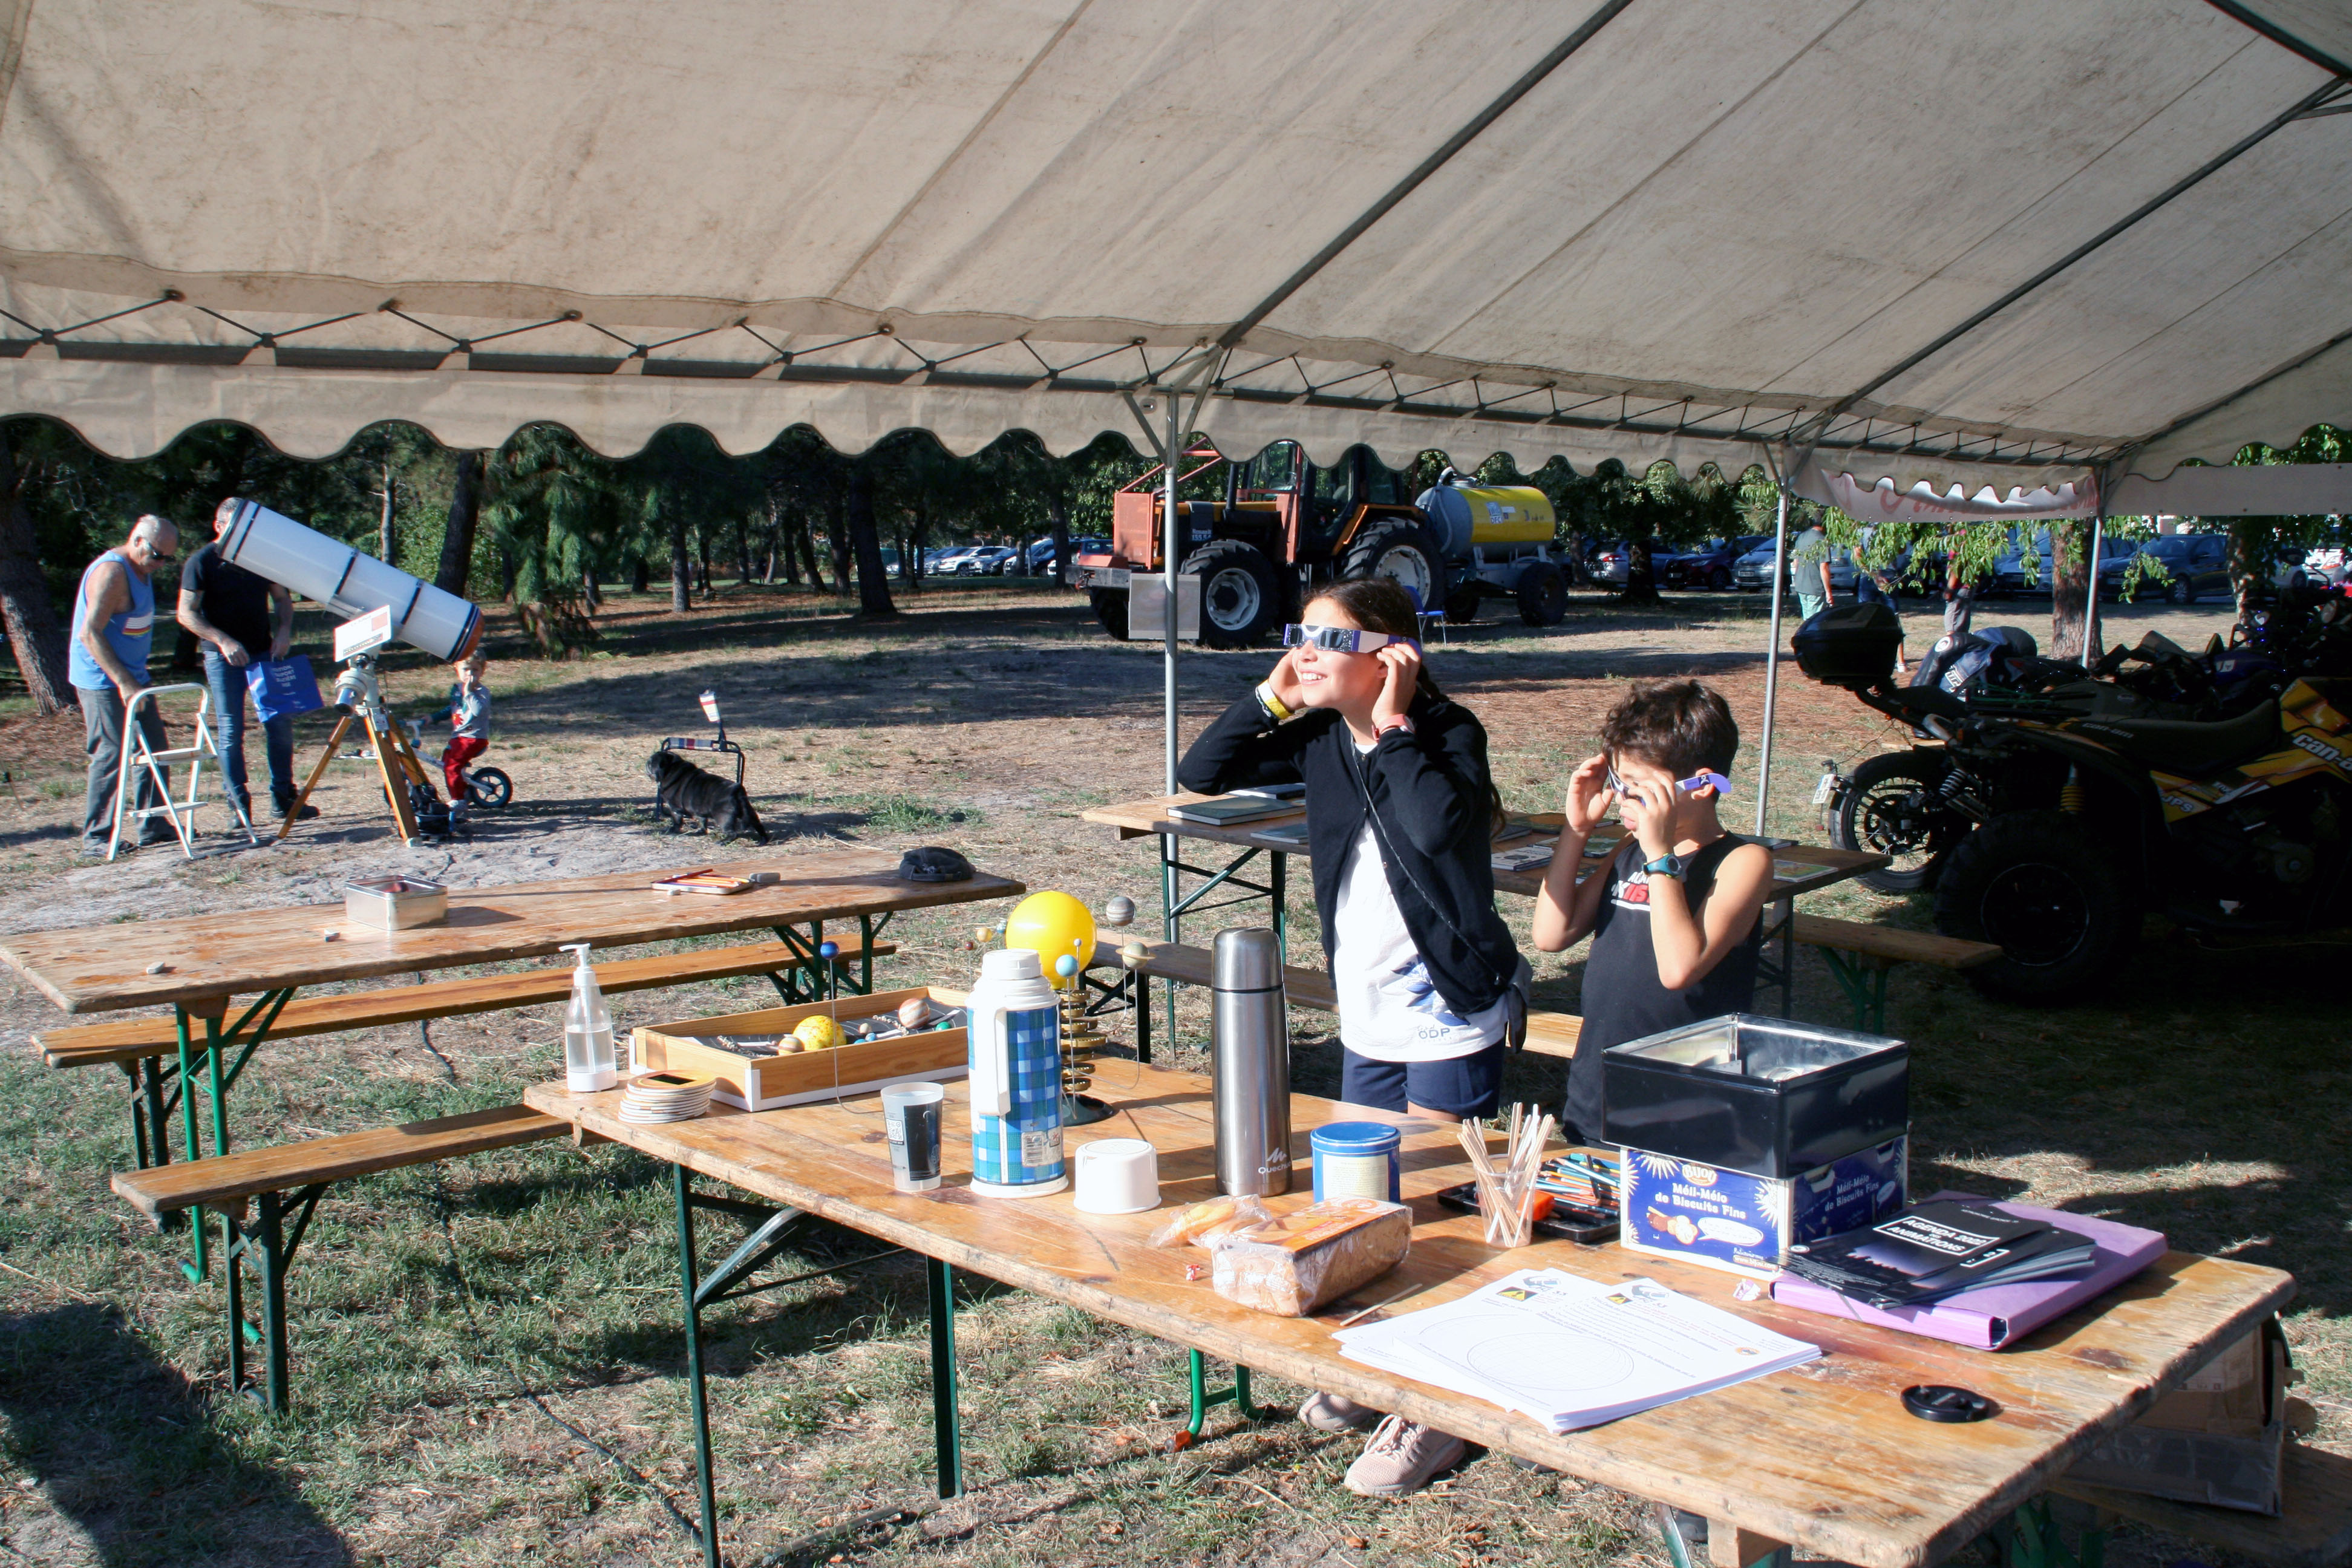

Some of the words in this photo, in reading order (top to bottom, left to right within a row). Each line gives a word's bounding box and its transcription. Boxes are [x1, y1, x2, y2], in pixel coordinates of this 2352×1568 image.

[1418, 1027, 1450, 1039] ODP
[1672, 1183, 1728, 1203] Méli-Mélo
[1836, 1174, 1869, 1195] Méli-Mélo
[1655, 1192, 1670, 1203] de
[1672, 1194, 1719, 1214] Biscuits
[1722, 1204, 1746, 1220] Fins
[1824, 1201, 1834, 1212] de
[1836, 1188, 1864, 1207] Biscuits
[1866, 1181, 1879, 1194] Fins
[1886, 1226, 1966, 1252] ANIMATIONS
[1902, 1219, 1957, 1238] AGENDA
